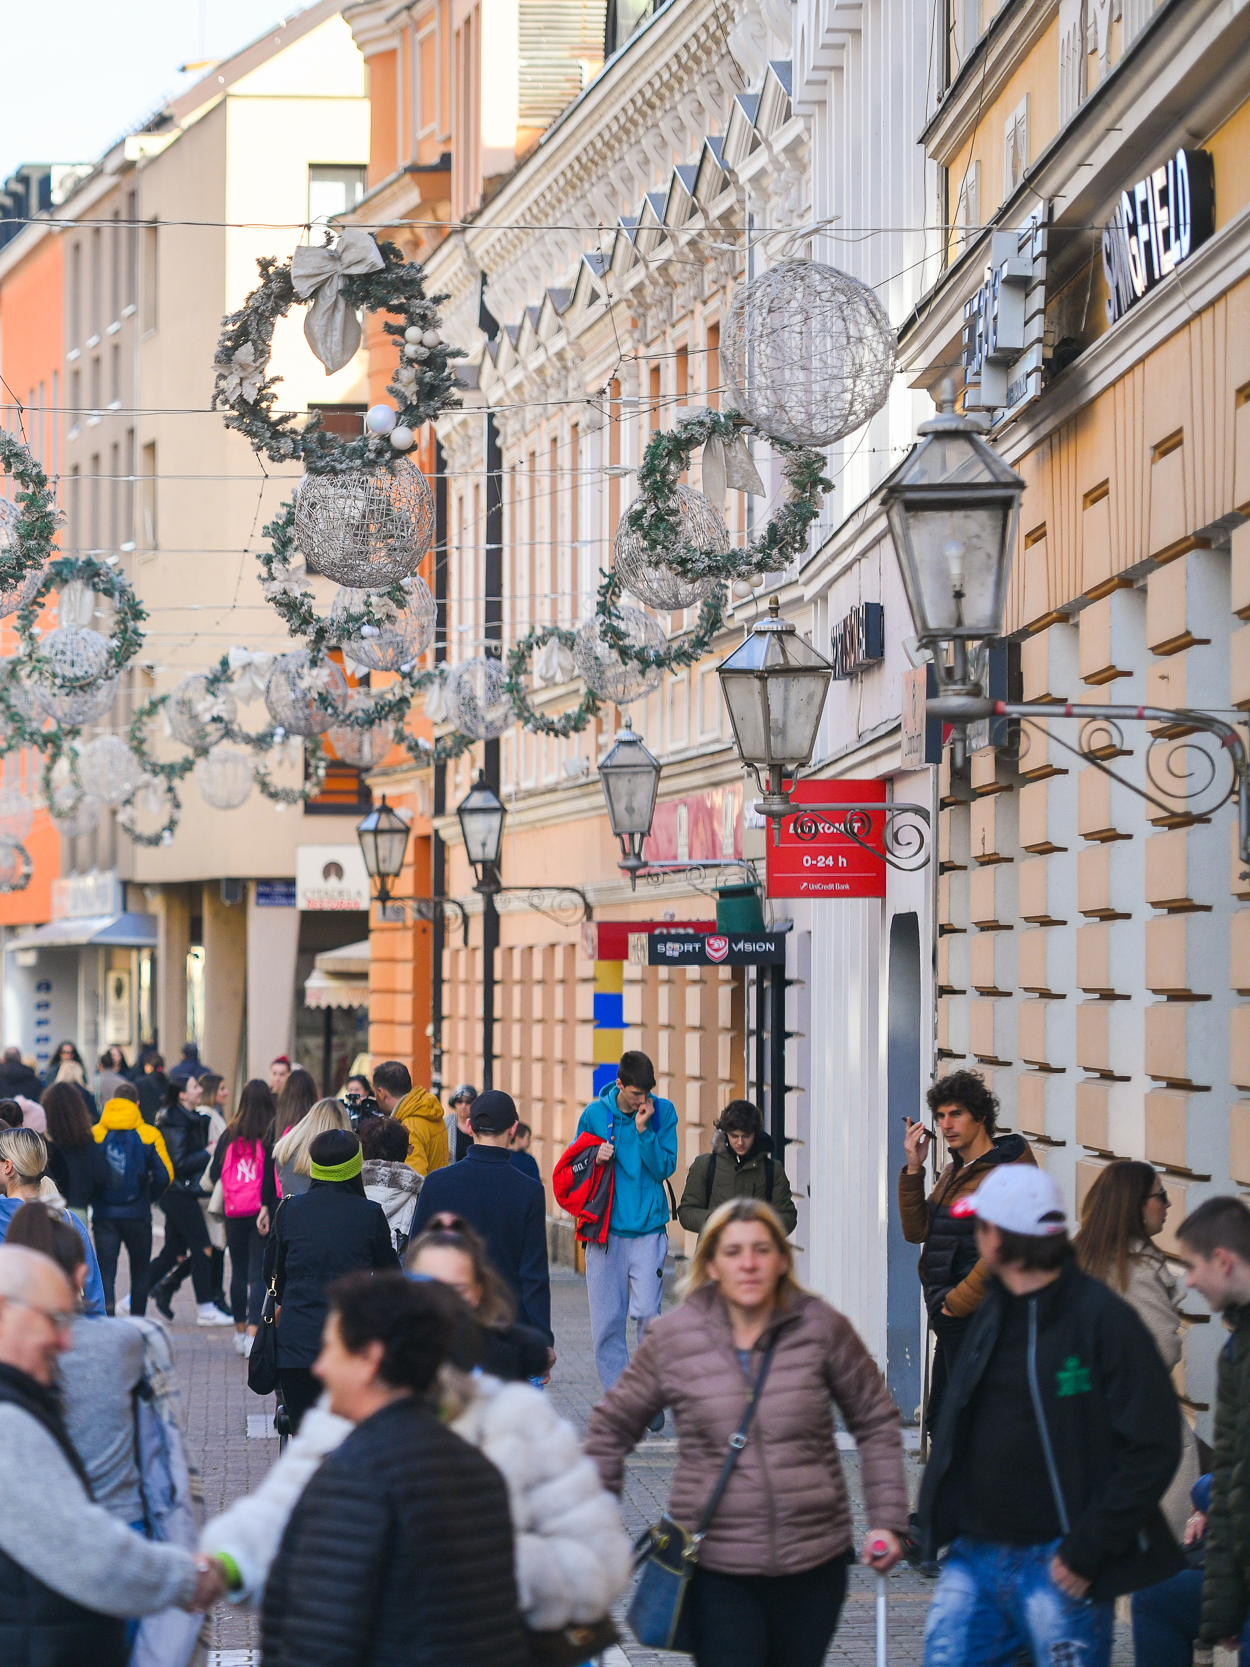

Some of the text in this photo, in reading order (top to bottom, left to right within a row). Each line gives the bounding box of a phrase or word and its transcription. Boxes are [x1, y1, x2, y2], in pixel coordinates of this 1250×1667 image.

[802, 855, 847, 868] 0-24 h
[809, 882, 850, 891] UniCredit Bank
[657, 939, 775, 953] SORT VISION
